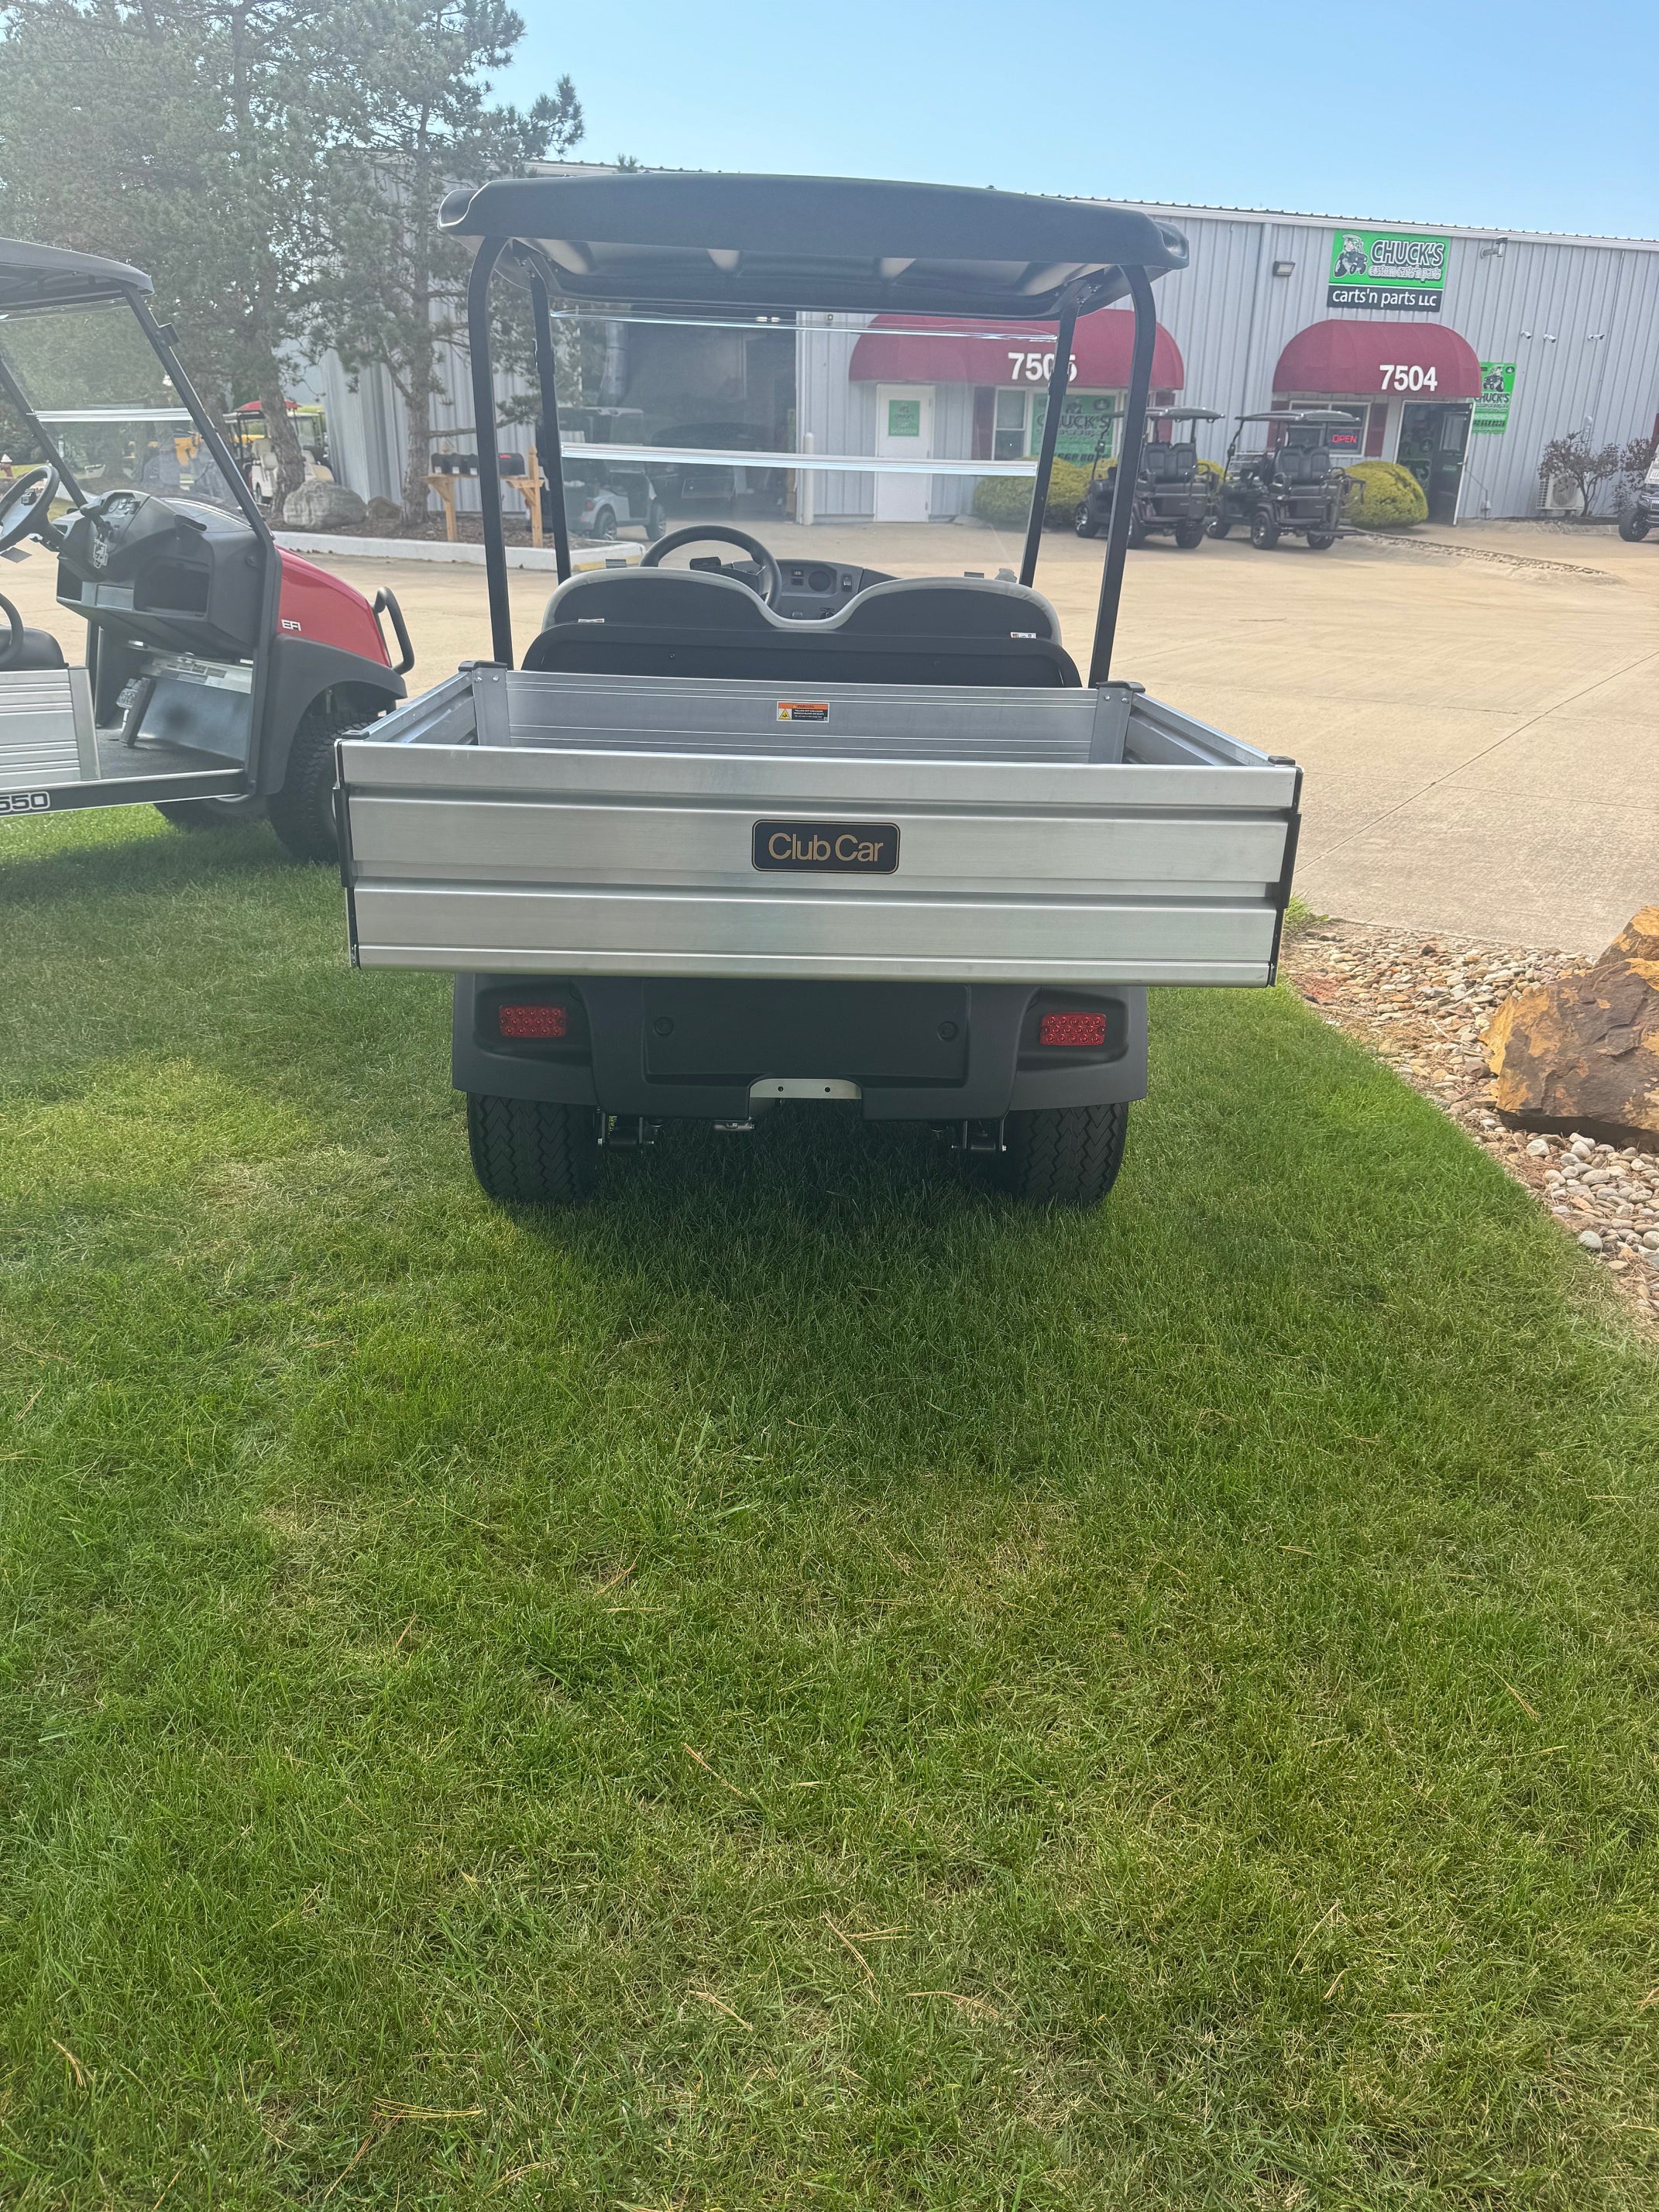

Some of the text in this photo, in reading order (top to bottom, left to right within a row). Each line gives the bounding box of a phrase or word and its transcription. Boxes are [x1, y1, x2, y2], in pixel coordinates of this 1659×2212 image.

[1370, 239, 1445, 266] CHUCK'S
[1332, 288, 1437, 307] carts'n parts LLC
[1379, 364, 1438, 391] 7504
[1036, 414, 1110, 429] CUCK'S
[1331, 434, 1358, 444] OPEN
[0, 791, 50, 812] 550
[768, 832, 884, 862] Club Car
